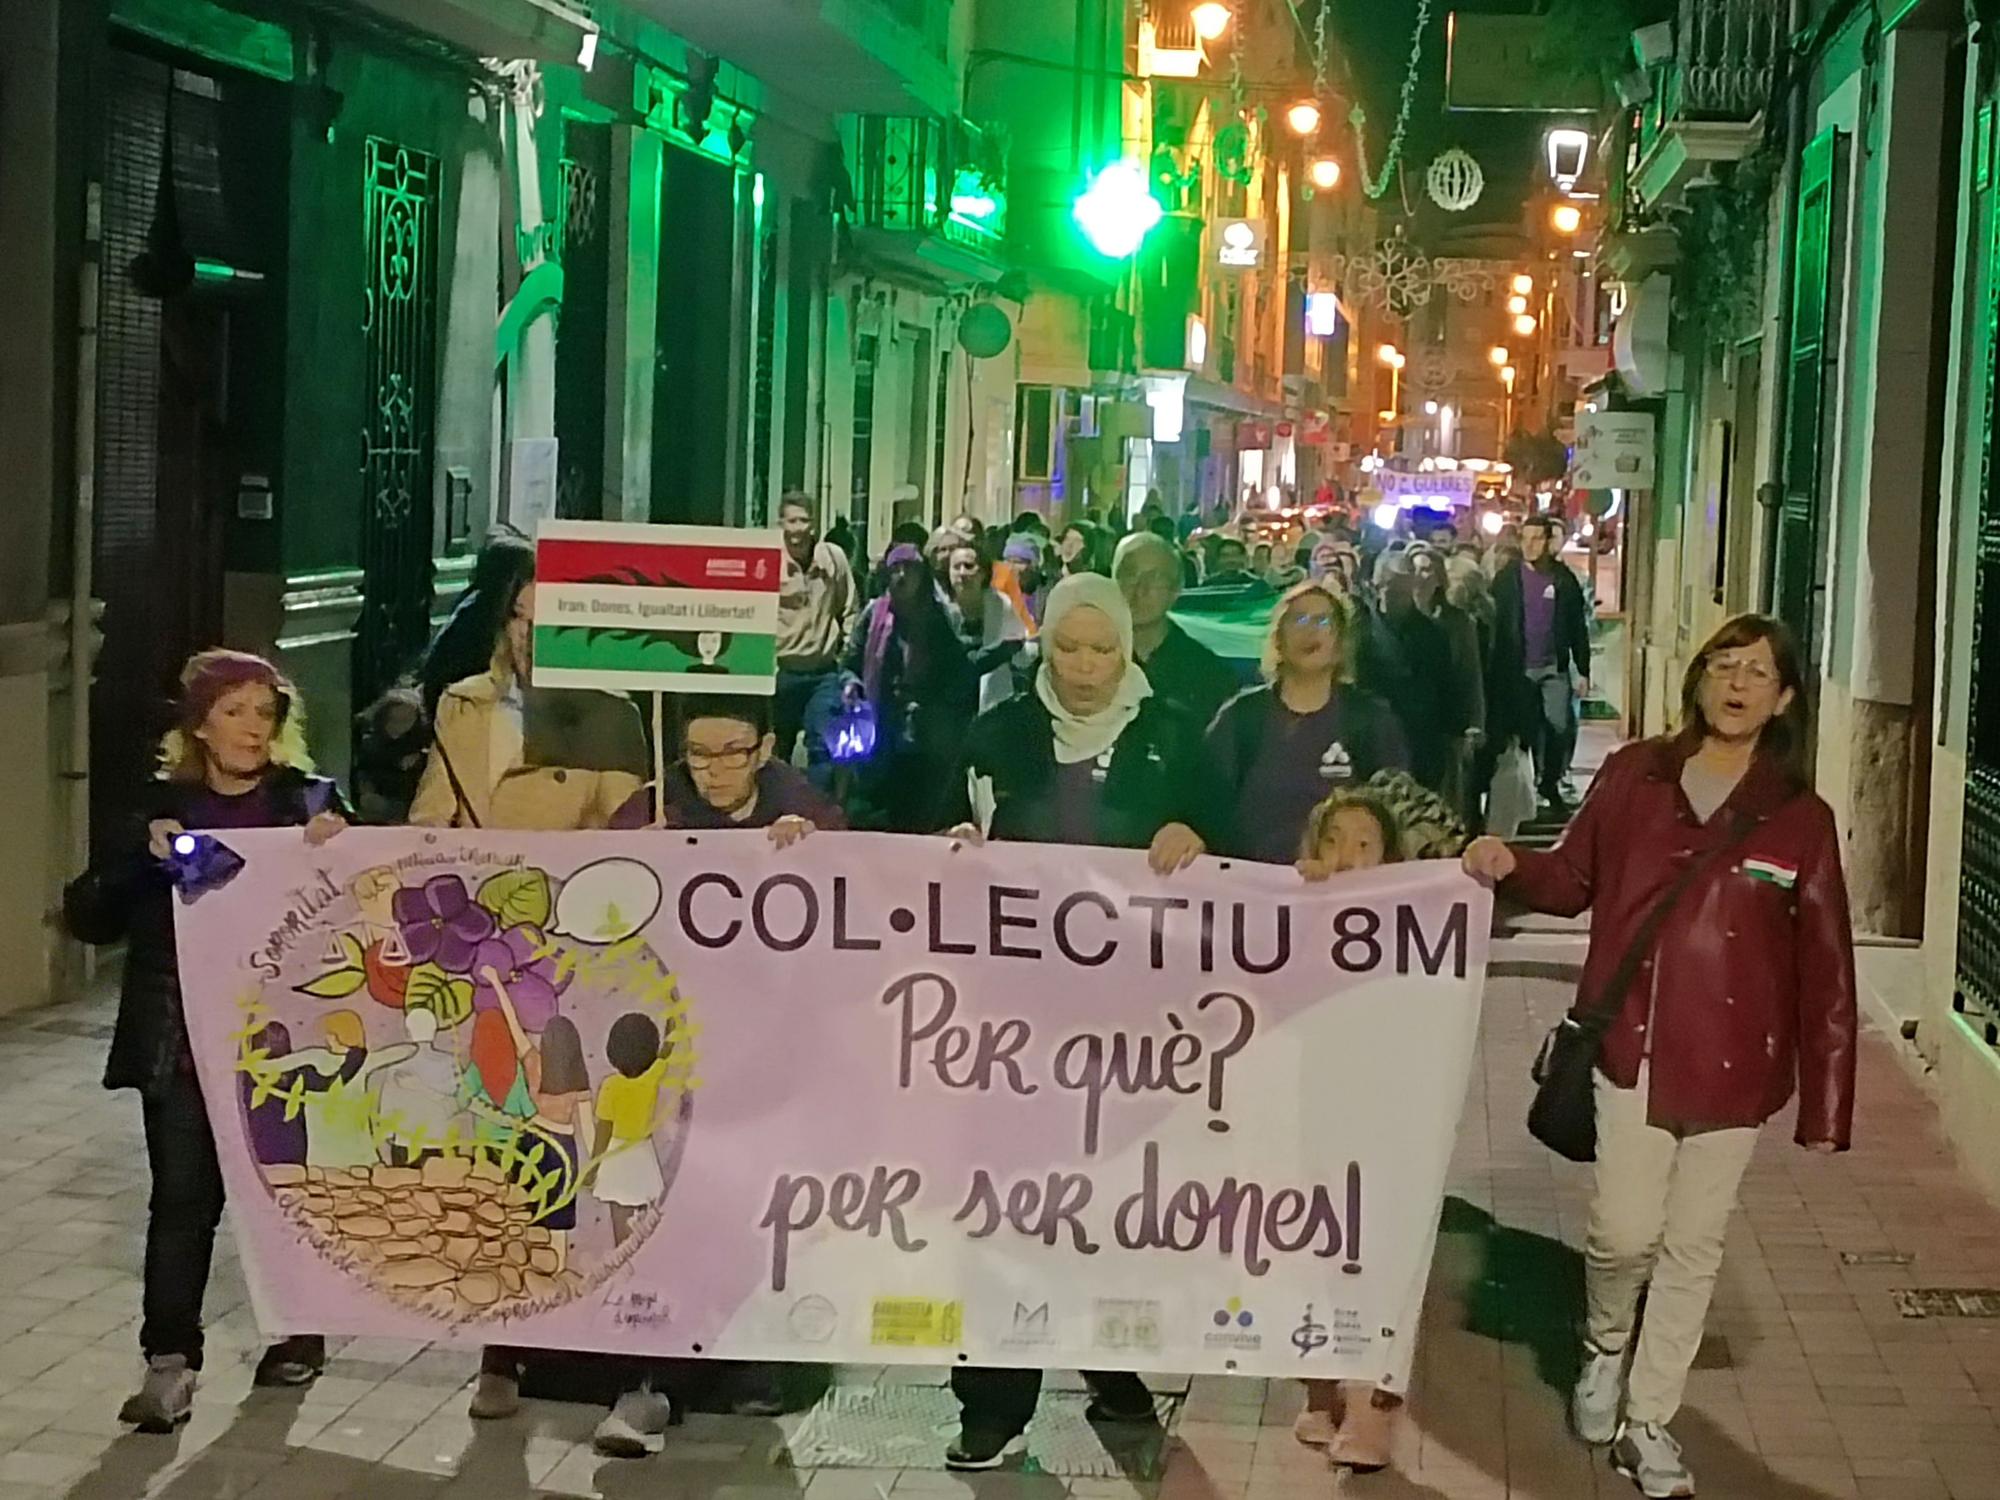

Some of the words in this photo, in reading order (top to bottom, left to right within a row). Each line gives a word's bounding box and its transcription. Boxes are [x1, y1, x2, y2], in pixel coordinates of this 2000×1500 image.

[1331, 903, 1469, 978] 8M
[1053, 990, 1257, 1155] què?
[1114, 1140, 1363, 1277] dones!
